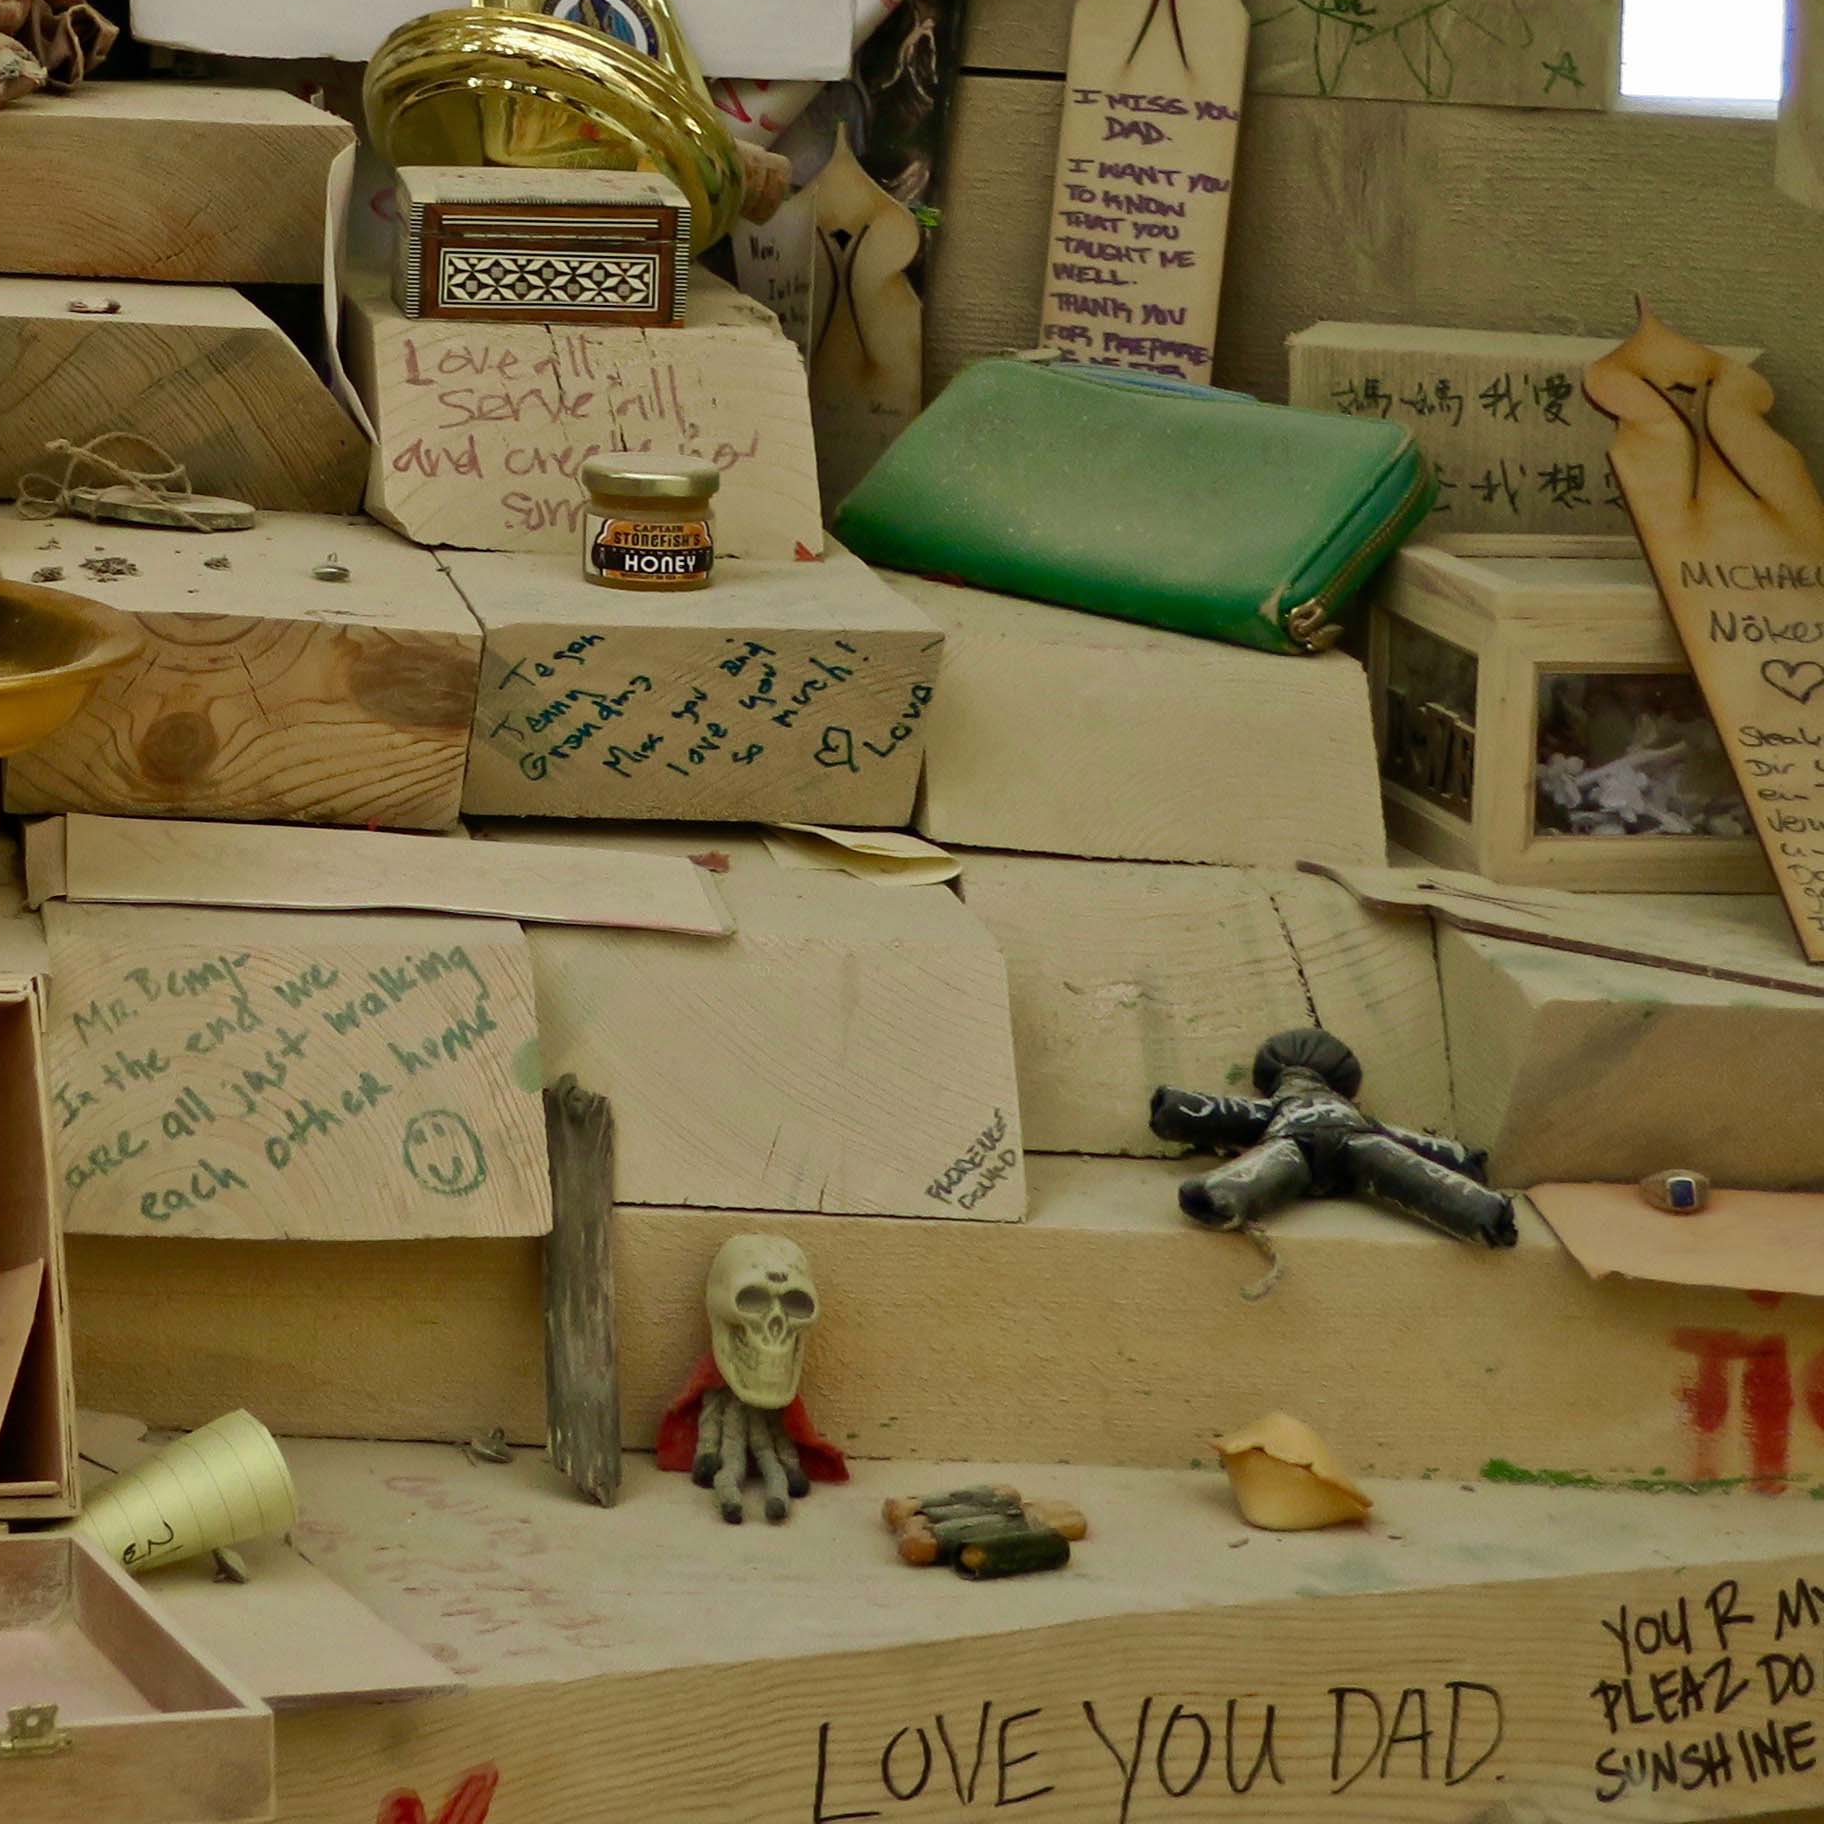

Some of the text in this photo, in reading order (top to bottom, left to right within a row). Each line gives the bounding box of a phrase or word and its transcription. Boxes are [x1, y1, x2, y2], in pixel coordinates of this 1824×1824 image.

[1104, 93, 1190, 116] MISS
[624, 554, 697, 574] HONEY
[1601, 1578, 1757, 1670] YOU R
[810, 1698, 1057, 1824] LOVE
[1083, 1694, 1289, 1824] YOU
[1592, 1721, 1819, 1805] SUNSHINE
